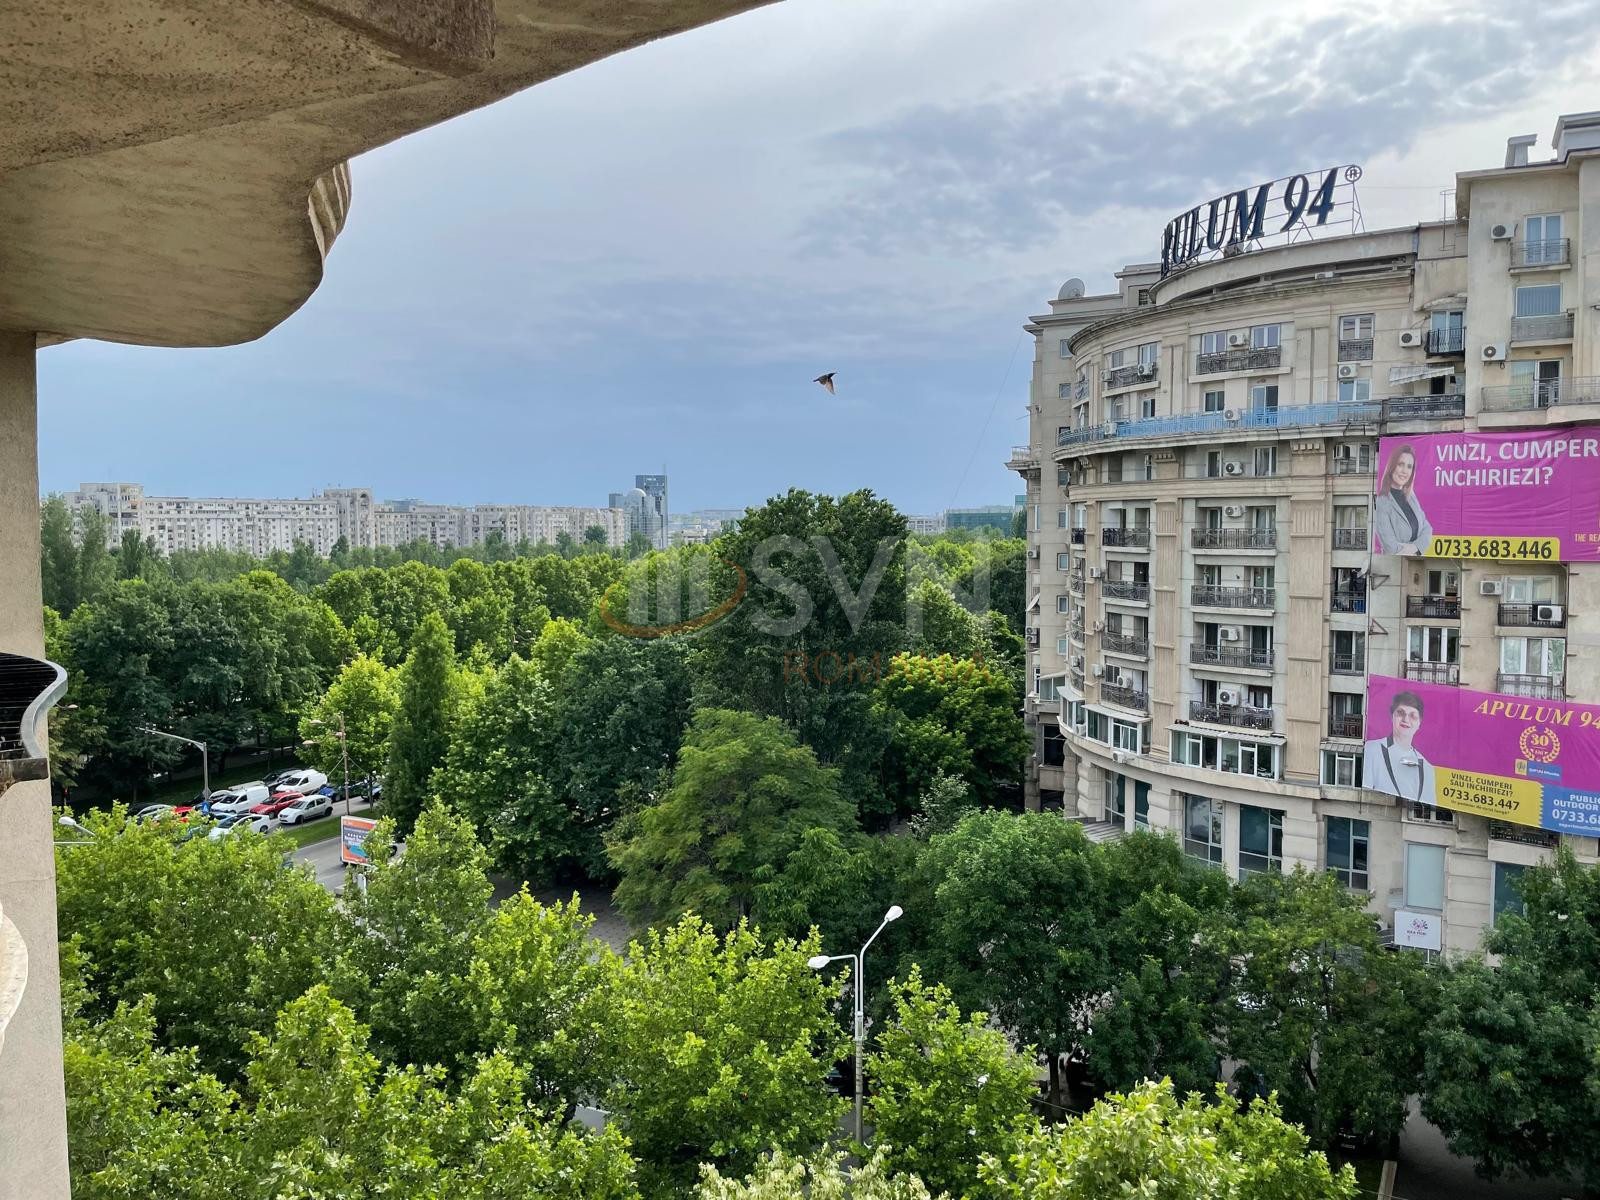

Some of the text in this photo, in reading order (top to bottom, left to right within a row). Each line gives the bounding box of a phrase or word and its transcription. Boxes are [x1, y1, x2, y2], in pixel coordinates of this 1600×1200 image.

[1280, 167, 1339, 232] 94
[1436, 438, 1599, 463] VINZI, CUMPER
[1434, 466, 1554, 486] ÎNCHIRIEZI?
[1434, 538, 1552, 560] 0733.683.446
[1473, 699, 1574, 726] APULUM
[1530, 733, 1549, 746] 30
[1450, 779, 1465, 788] SAU
[1476, 777, 1513, 790] CUMPERI
[1443, 786, 1520, 811] 0733.683.447
[1553, 798, 1599, 811] OUTDOOR
